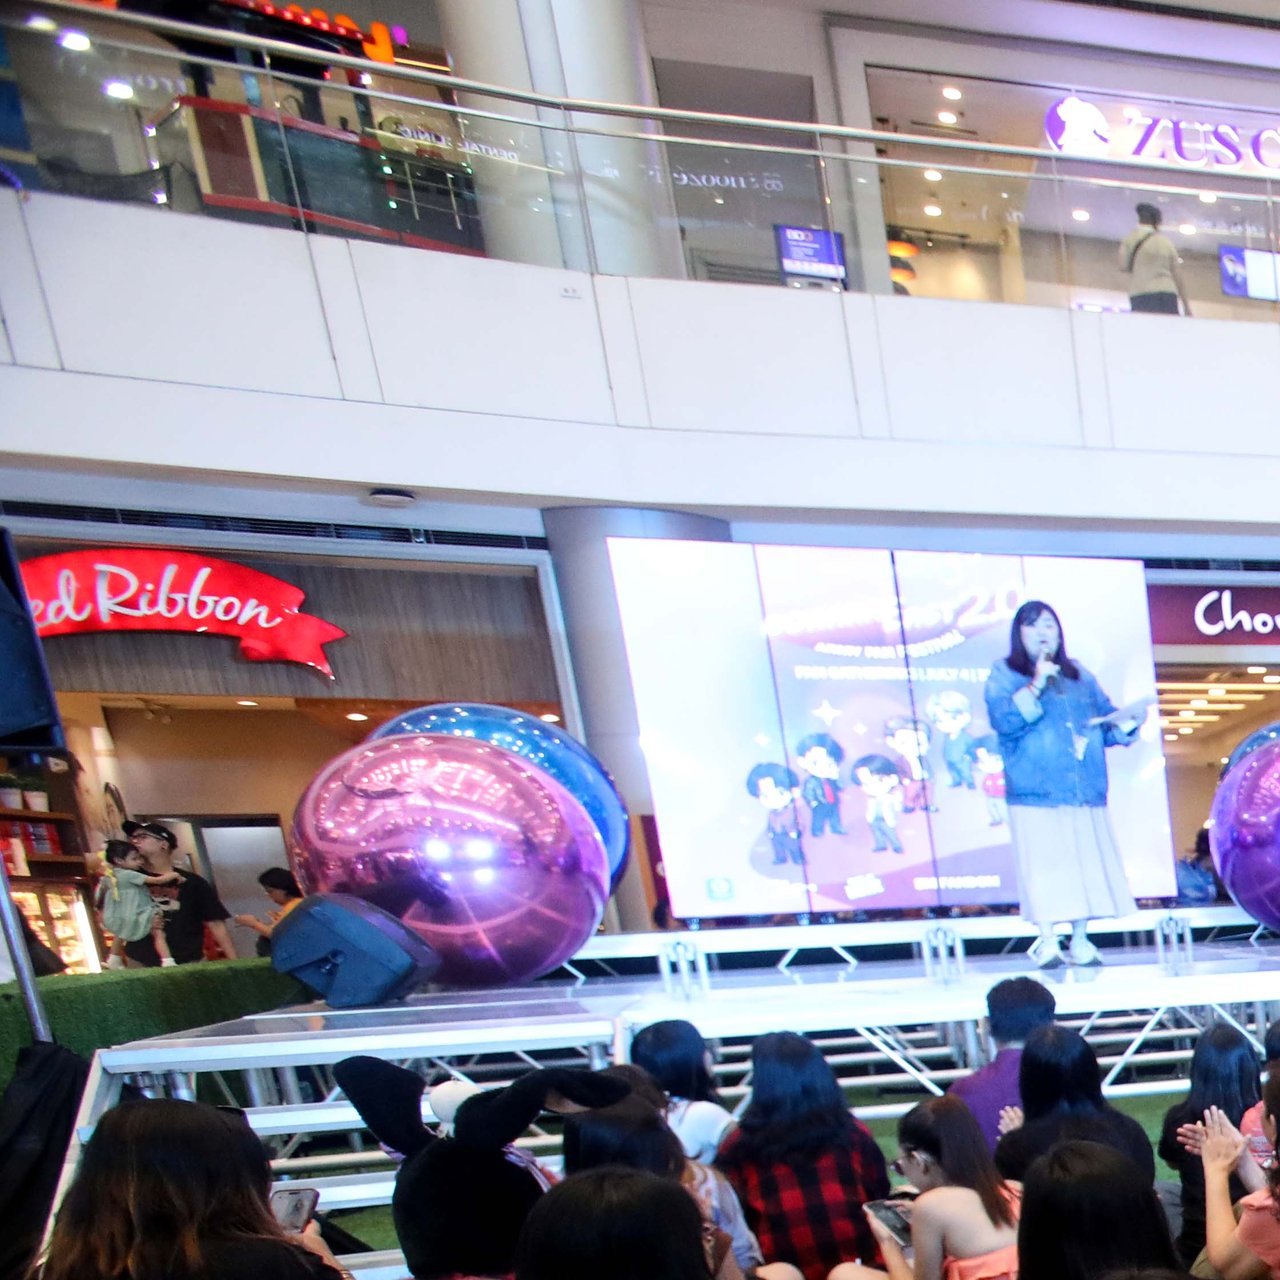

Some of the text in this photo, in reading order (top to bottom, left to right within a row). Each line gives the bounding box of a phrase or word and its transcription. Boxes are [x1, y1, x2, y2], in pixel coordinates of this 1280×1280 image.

[1121, 109, 1244, 169] ZUS
[31, 563, 283, 628] ed Ribbon
